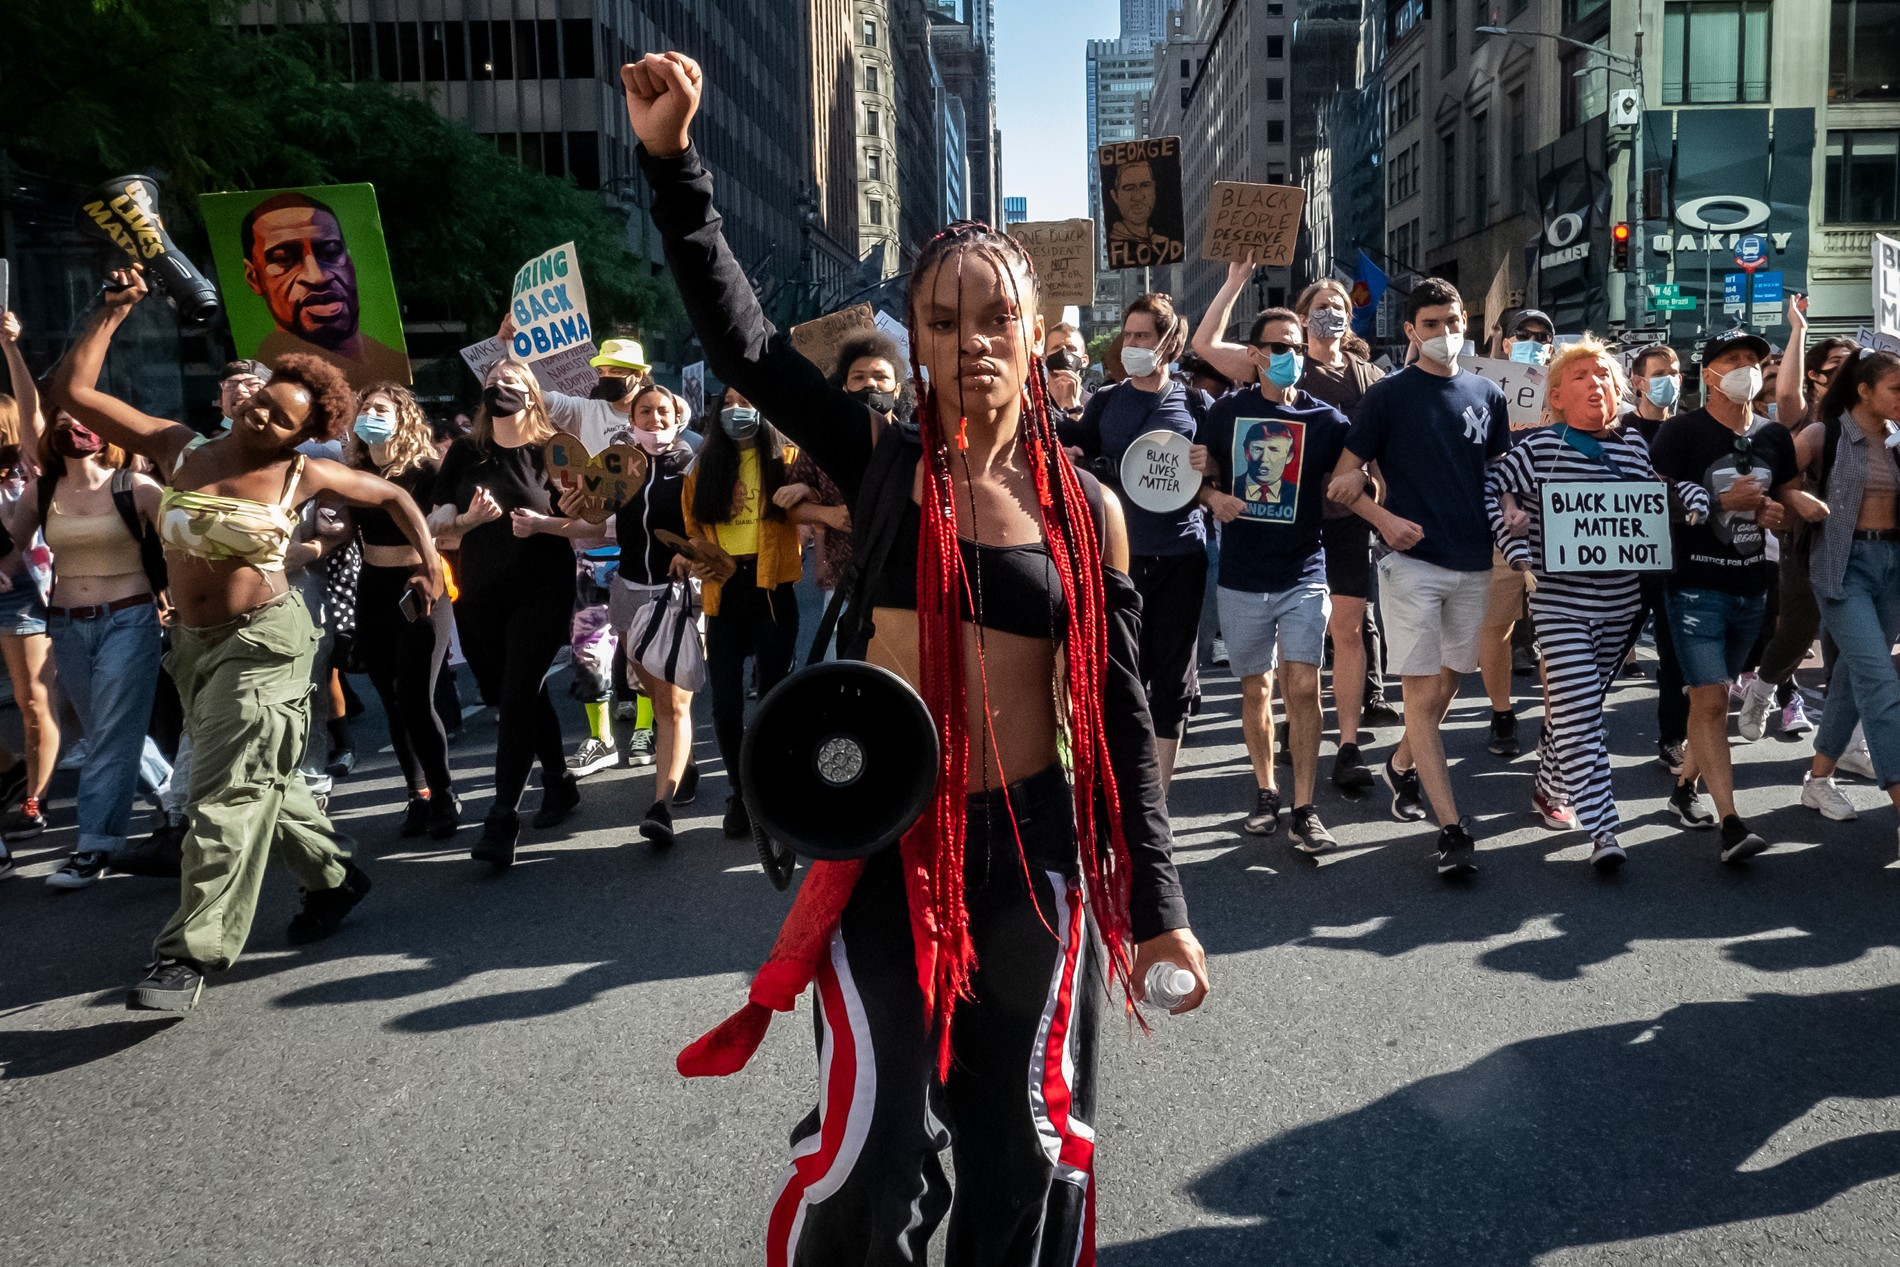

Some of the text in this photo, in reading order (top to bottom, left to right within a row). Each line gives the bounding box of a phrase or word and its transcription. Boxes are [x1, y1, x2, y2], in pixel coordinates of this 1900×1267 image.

[1100, 138, 1175, 165] GEORGE
[1222, 188, 1292, 209] BLACK
[1217, 210, 1293, 229] PEOPLE
[1015, 228, 1087, 245] ONE BLACK
[1213, 229, 1284, 244] DESERVE
[1026, 245, 1085, 258] RESIDENT
[1111, 234, 1183, 266] FLOYD
[1210, 242, 1287, 261] BETTER
[513, 250, 568, 299] BRING
[1662, 286, 1672, 296] 46
[513, 283, 574, 326] BACK
[513, 312, 590, 357] OBAMA
[463, 337, 503, 363] WAKE
[553, 444, 642, 477] BLACK
[1146, 449, 1179, 467] BLACK
[1149, 464, 1176, 478] LIVES
[1138, 475, 1180, 492] MATTER
[1551, 492, 1664, 515] BLACK LIVES
[1574, 517, 1650, 538] MATTER.
[1560, 544, 1661, 565] I DO NOT.
